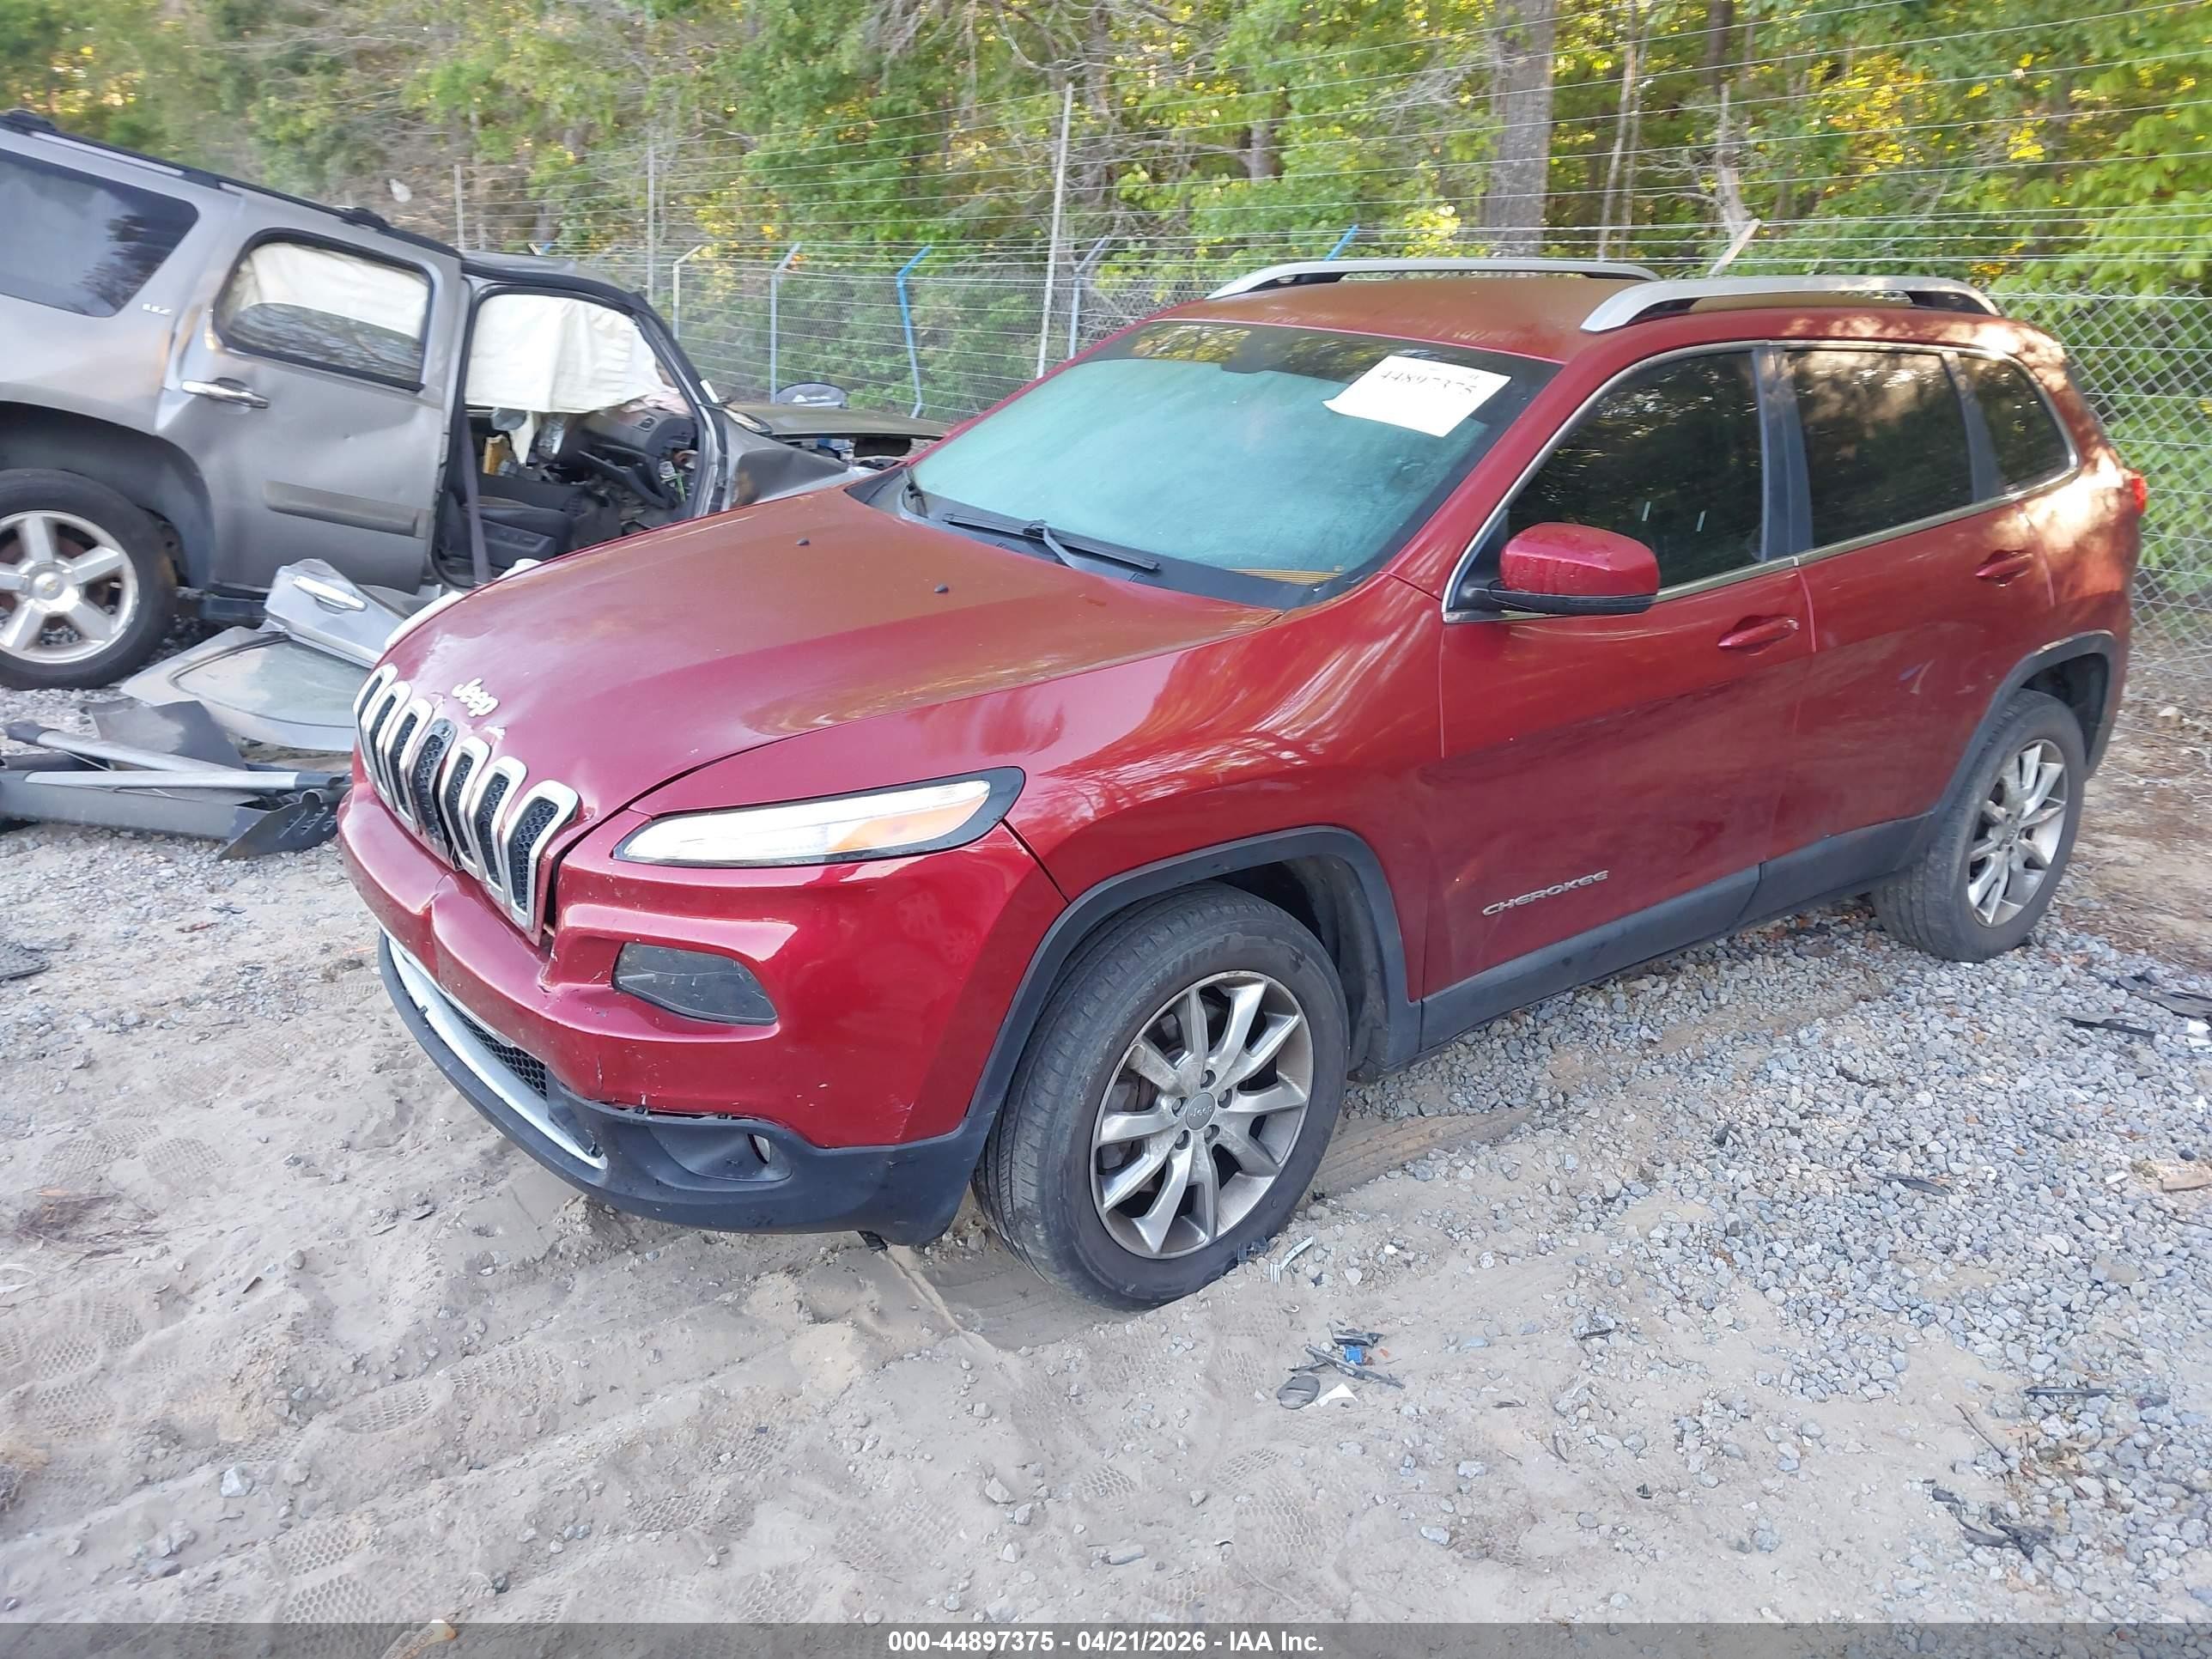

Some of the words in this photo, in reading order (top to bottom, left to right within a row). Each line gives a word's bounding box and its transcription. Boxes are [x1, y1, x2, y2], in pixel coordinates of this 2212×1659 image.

[451, 678, 500, 718] Jeep
[1482, 870, 1609, 916] CHEROKEE
[1189, 1105, 1212, 1118] Jeep
